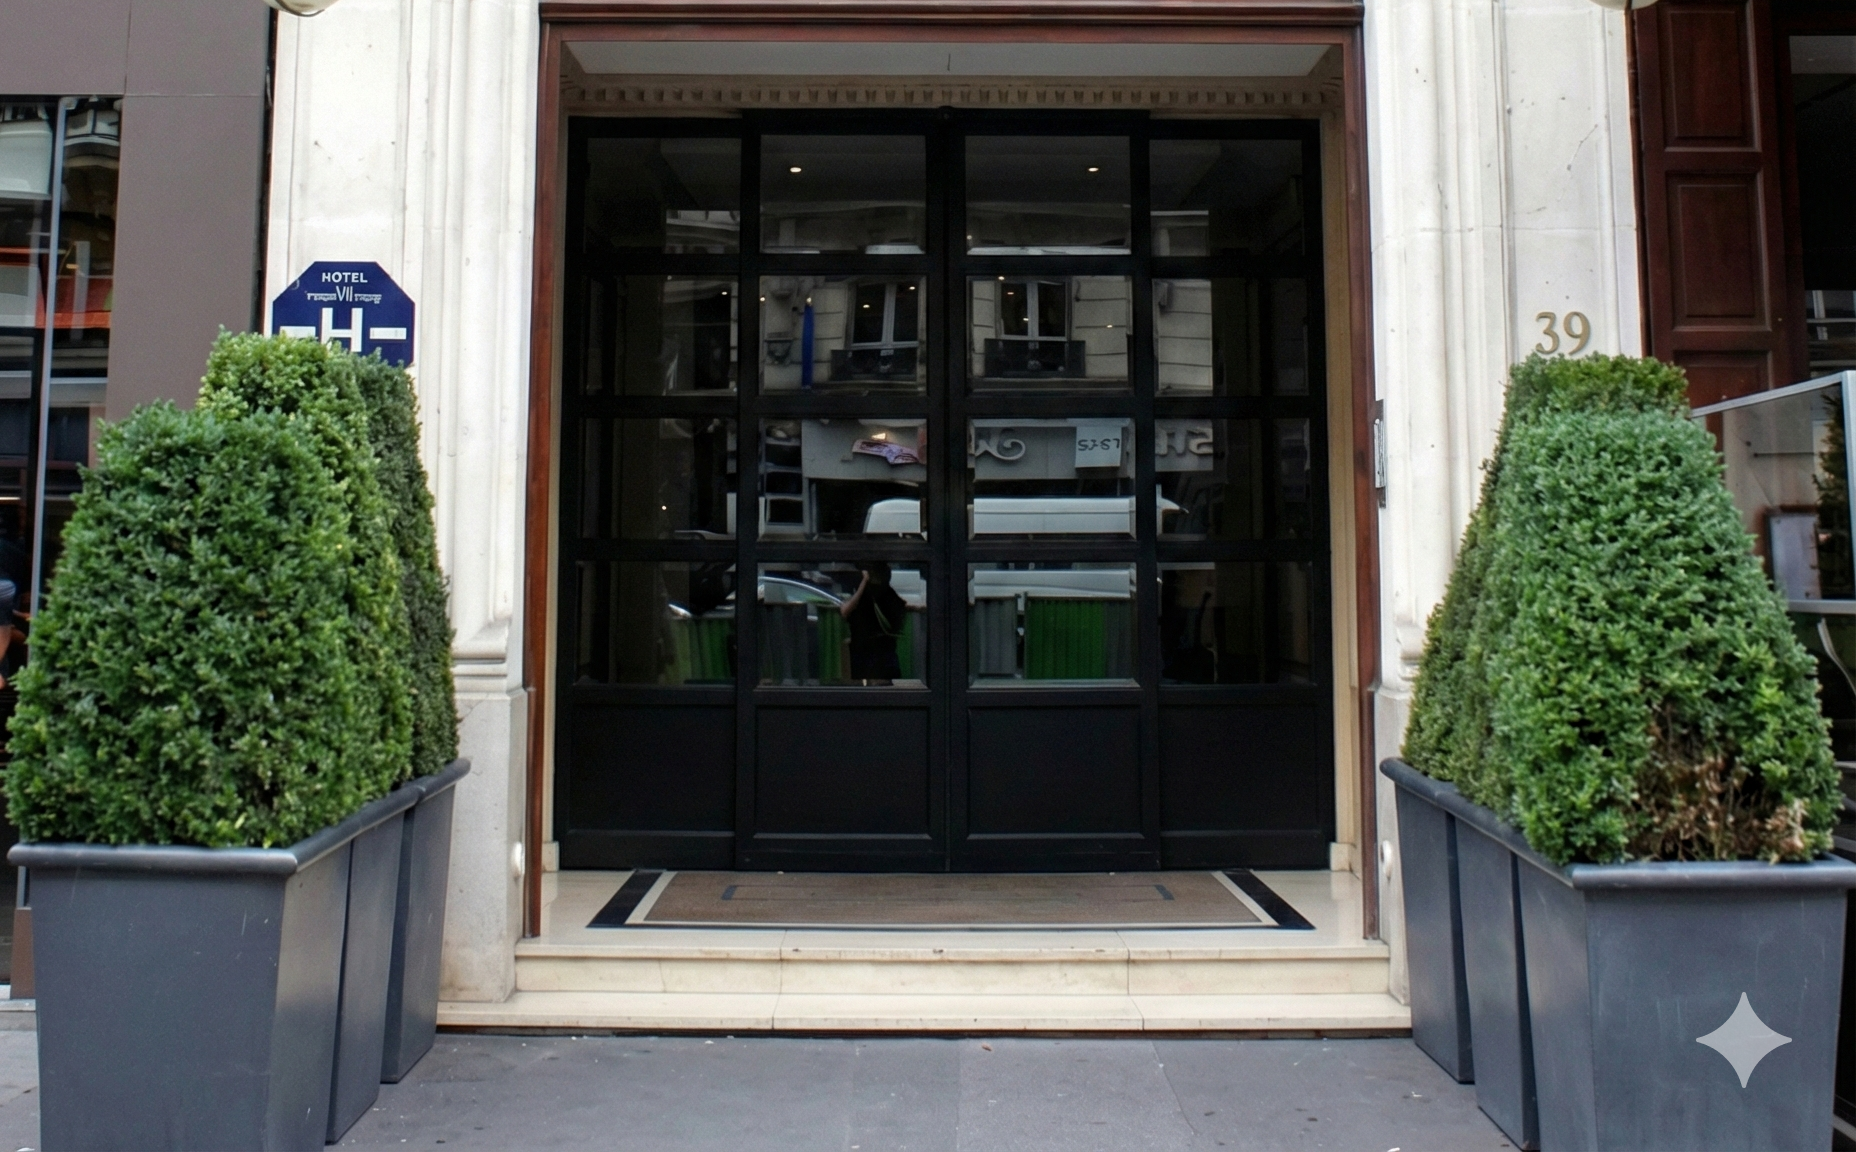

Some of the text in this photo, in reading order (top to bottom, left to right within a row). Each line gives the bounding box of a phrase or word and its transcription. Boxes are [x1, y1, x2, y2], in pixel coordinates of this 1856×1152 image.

[321, 272, 368, 283] HOTEL
[336, 285, 353, 302] VII
[1535, 311, 1591, 356] 39
